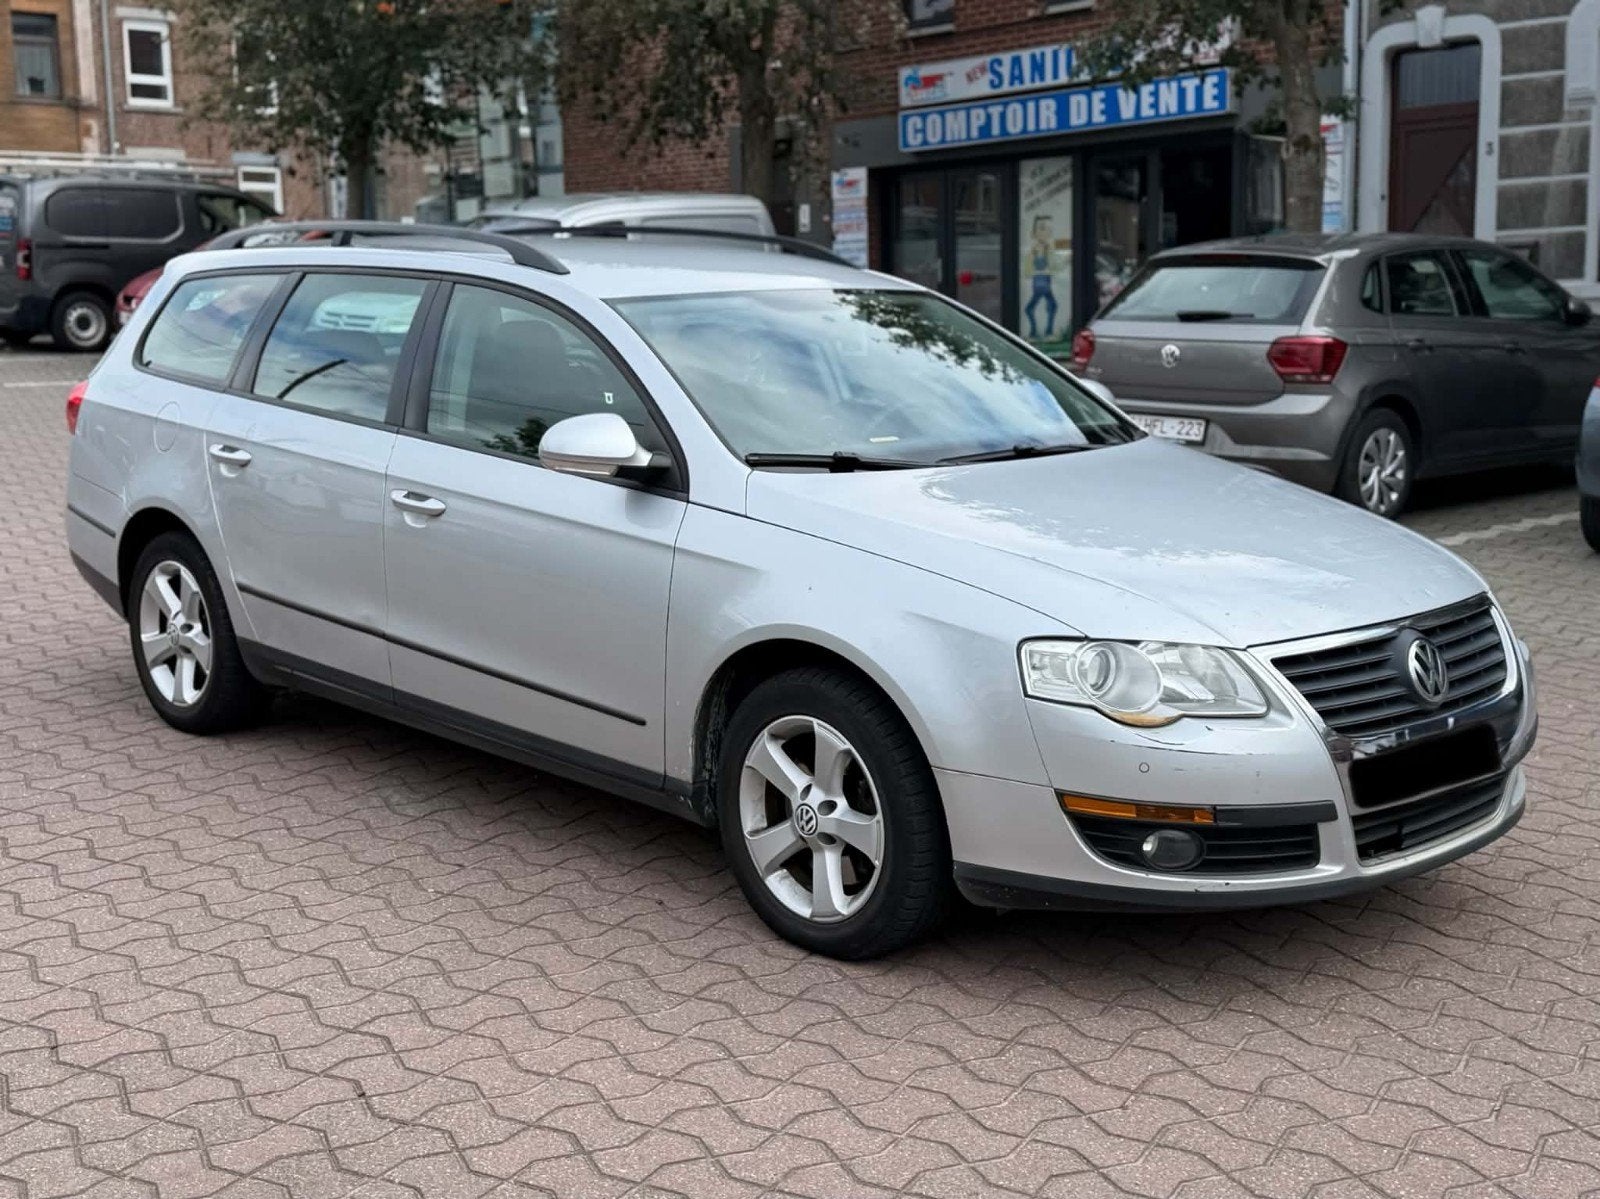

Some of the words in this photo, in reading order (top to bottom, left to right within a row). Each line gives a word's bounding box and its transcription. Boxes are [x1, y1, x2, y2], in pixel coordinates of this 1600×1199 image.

[906, 98, 1057, 146] COMPTOIR
[1069, 91, 1106, 127] DE
[1117, 75, 1219, 120] VENTE
